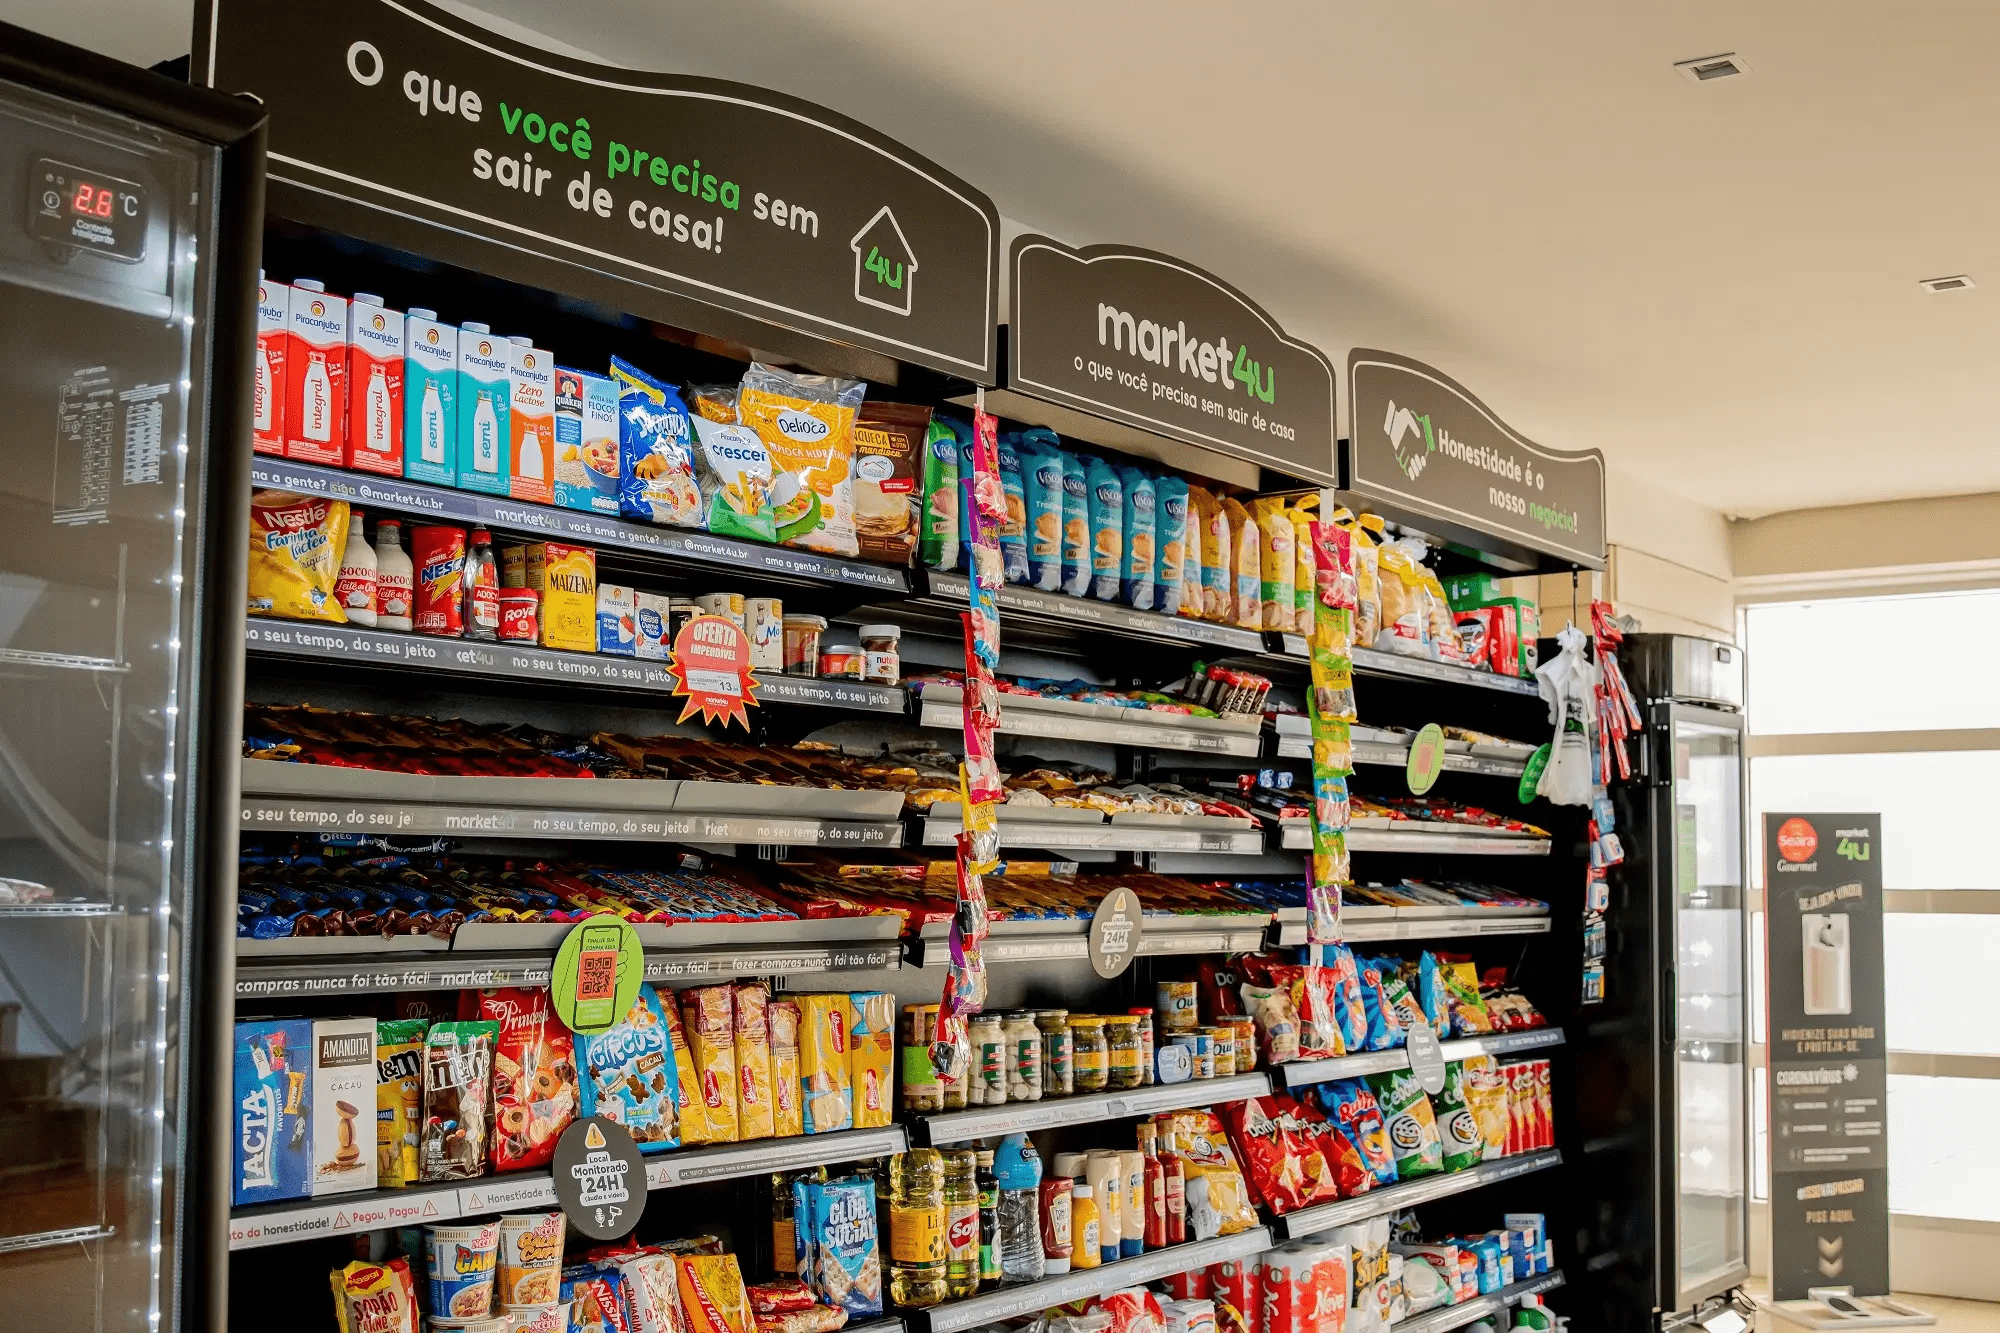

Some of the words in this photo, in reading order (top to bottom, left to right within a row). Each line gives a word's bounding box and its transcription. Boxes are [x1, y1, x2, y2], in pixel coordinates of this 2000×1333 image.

[346, 41, 384, 86] O
[403, 70, 483, 122] que
[500, 102, 593, 160] você
[608, 140, 741, 211] precisa
[753, 191, 819, 238] sem
[472, 146, 552, 196] sair
[567, 171, 613, 218] de
[628, 200, 724, 254] casa!
[864, 246, 903, 290] 4u
[296, 313, 341, 332] Piracanjuba
[359, 326, 399, 346] Piracanjuba
[414, 340, 451, 358] Piracanjuba
[1098, 302, 1275, 404] market4u
[465, 354, 505, 370] Piracanjuba
[510, 366, 548, 382] Piracanjuba
[513, 394, 545, 407] Lactose
[518, 383, 543, 397] Zero
[1074, 355, 1083, 371] o
[1088, 359, 1113, 382] que
[1117, 369, 1148, 392] você
[1152, 380, 1197, 410] precisa
[1201, 397, 1224, 418] sem
[1227, 405, 1249, 426] sair
[1252, 411, 1266, 432] de
[1270, 420, 1295, 441] casa
[312, 378, 326, 430] integral
[373, 389, 387, 440] integral
[555, 395, 583, 410] QUAKER
[588, 400, 616, 414] FLOCOS
[591, 410, 613, 423] FINOS
[426, 410, 437, 449] semi
[479, 421, 490, 459] semi
[1438, 427, 1522, 483] Honestidade
[1525, 460, 1533, 487] é
[1536, 472, 1544, 491] o
[272, 474, 281, 483] a
[284, 477, 327, 491] gente?
[360, 485, 444, 510] @market4u.br
[263, 503, 327, 529] Nestlé
[1489, 486, 1526, 516] nosso
[1529, 501, 1578, 535] negócio!
[267, 527, 318, 550] Farinha
[495, 508, 561, 530] market4u
[568, 522, 592, 533] você
[595, 527, 616, 538] ama
[619, 531, 626, 539] a
[628, 531, 660, 545] gente?
[684, 539, 748, 560] @market4u.br
[290, 533, 328, 560] láctea
[765, 554, 784, 567] ama
[786, 560, 792, 568] a
[794, 560, 821, 575] gente?
[823, 566, 840, 577] siga
[841, 567, 896, 586] @market4u.br
[550, 573, 594, 596] MAIZENA
[264, 630, 290, 643] seu
[295, 631, 349, 651] tempo,
[353, 637, 371, 650] do
[375, 642, 400, 655] seu
[404, 642, 436, 658] jeito
[693, 621, 737, 647] OFERTA
[690, 643, 736, 661] IMPERDÍVEL
[513, 656, 528, 668] no
[532, 659, 554, 671] seu
[558, 660, 600, 677] tempo,
[603, 664, 618, 676] do
[621, 669, 641, 679] seu
[645, 669, 671, 683] jeito
[764, 683, 776, 693] no
[779, 685, 796, 695] seu
[799, 686, 833, 701] tempo,
[836, 690, 847, 700] do
[850, 693, 865, 703] seu
[868, 693, 889, 706] jeito
[257, 810, 283, 822] seu
[289, 808, 342, 826] tempo,
[347, 809, 365, 824] do
[369, 813, 393, 825] seu
[533, 818, 549, 831] no
[553, 820, 574, 832] seu
[578, 818, 620, 837] tempo,
[622, 819, 637, 833] do
[641, 822, 661, 833] seu
[663, 820, 689, 837] jeito
[757, 826, 770, 837] no
[773, 827, 790, 838] seu
[793, 826, 827, 842] tempo,
[829, 826, 842, 838] do
[844, 829, 860, 840] seu
[861, 827, 884, 842] jeito
[1836, 838, 1869, 860] 4u
[1106, 932, 1125, 944] 24H
[647, 962, 662, 976] foi
[665, 963, 684, 976] tão
[687, 960, 709, 974] fácil
[732, 957, 757, 972] fazer
[761, 958, 802, 972] compras
[804, 956, 831, 968] nunca
[849, 955, 864, 966] tão
[867, 952, 887, 966] fácil
[236, 977, 300, 995] compras
[304, 977, 346, 990] nunca
[352, 972, 370, 988] foi
[375, 973, 398, 986] tão
[402, 970, 430, 986] fácil
[441, 969, 511, 986] market4u
[323, 1038, 369, 1058] AMANDITA
[592, 1028, 663, 1067] CIRCUS
[639, 1055, 662, 1070] CACAU
[331, 1082, 362, 1091] CACAU
[275, 1088, 284, 1132] FAVORITOS
[243, 1088, 273, 1190] LACTA
[574, 1163, 627, 1176] Monitorado
[589, 1155, 608, 1163] Local
[586, 1174, 619, 1193] 24H
[247, 1228, 261, 1239] da
[264, 1218, 330, 1237] honestidade!
[353, 1209, 388, 1226] Pegou,
[389, 1205, 420, 1221] Pagou
[488, 1190, 544, 1205] Honestidade
[825, 1218, 877, 1249] SOCIAL
[840, 1247, 865, 1258] ORIGINAL
[353, 1291, 399, 1321] SOPÃO
